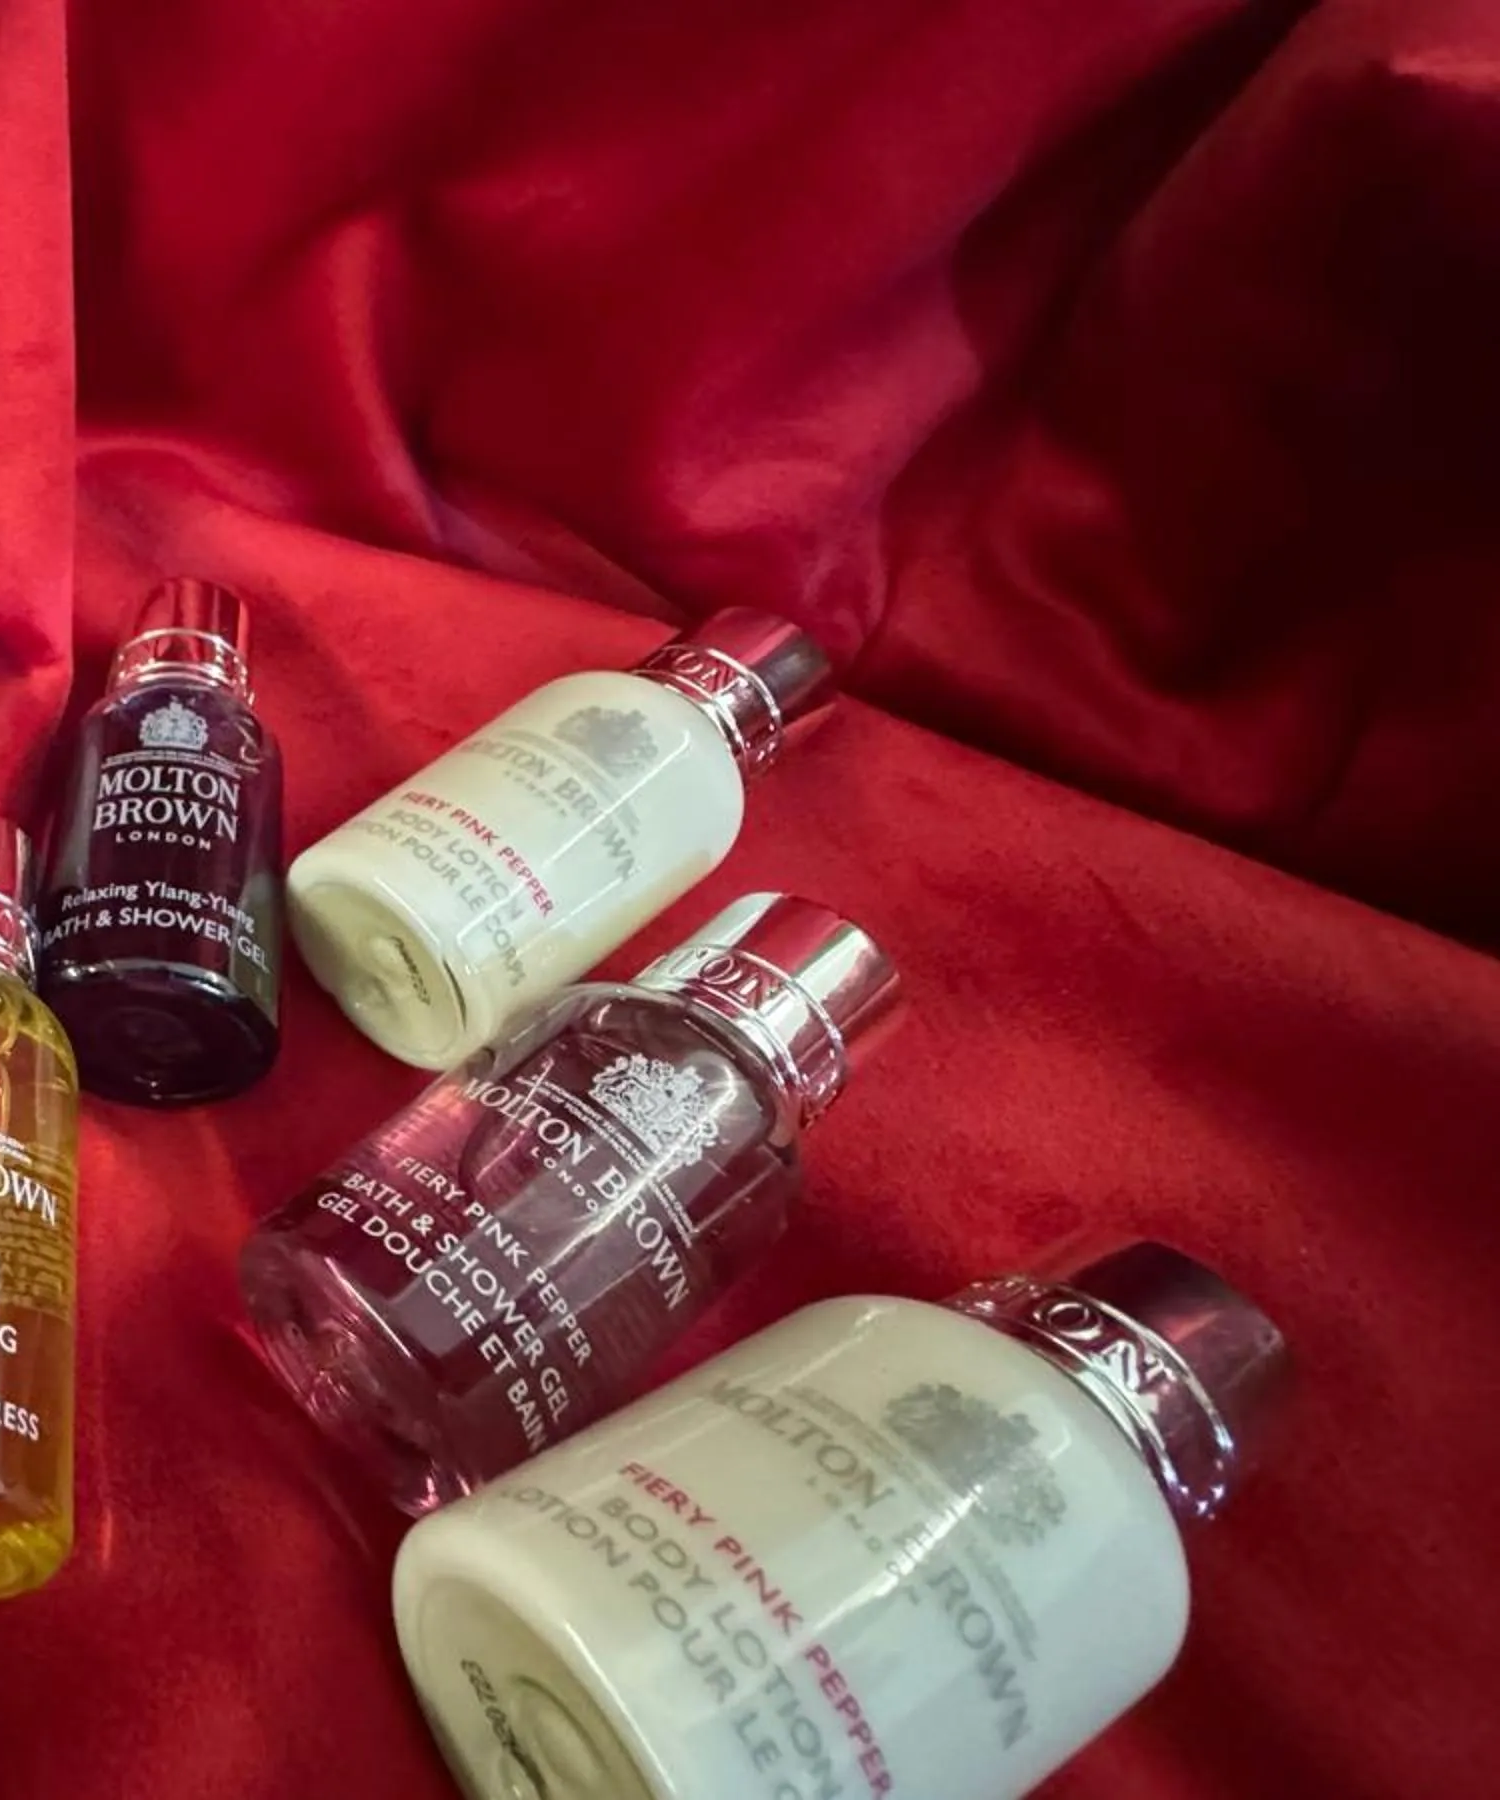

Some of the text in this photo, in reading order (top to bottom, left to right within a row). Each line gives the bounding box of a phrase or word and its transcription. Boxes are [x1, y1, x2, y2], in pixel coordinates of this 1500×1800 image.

[93, 797, 239, 843] BROWN
[98, 766, 240, 811] MOLTON
[115, 830, 211, 851] LONDON
[61, 880, 255, 933] Relaxing Ylang-Ylang
[387, 809, 524, 921] BODY LOTION
[400, 835, 462, 886] POUR
[459, 883, 486, 912] LE
[449, 808, 500, 846] PINK
[497, 846, 554, 917] PEPPER
[95, 909, 112, 928] &
[119, 907, 231, 947] SHOWER
[237, 936, 270, 973] GEL
[463, 1078, 596, 1166] MOLTON
[593, 1164, 691, 1312] BROWN
[531, 1146, 600, 1213] LONDO
[343, 1172, 569, 1423] BATH & SHOWER GEL
[396, 1156, 592, 1367] FIERY PINK PEPPER
[318, 1191, 547, 1451] GEL DOUCHE ET BAIN
[710, 1378, 895, 1510] MOLTON
[597, 1496, 844, 1800] BODY LOTION
[618, 1461, 893, 1800] FIERY PINK PEPPER
[629, 1570, 737, 1703] POUR
[733, 1711, 783, 1774] LE
